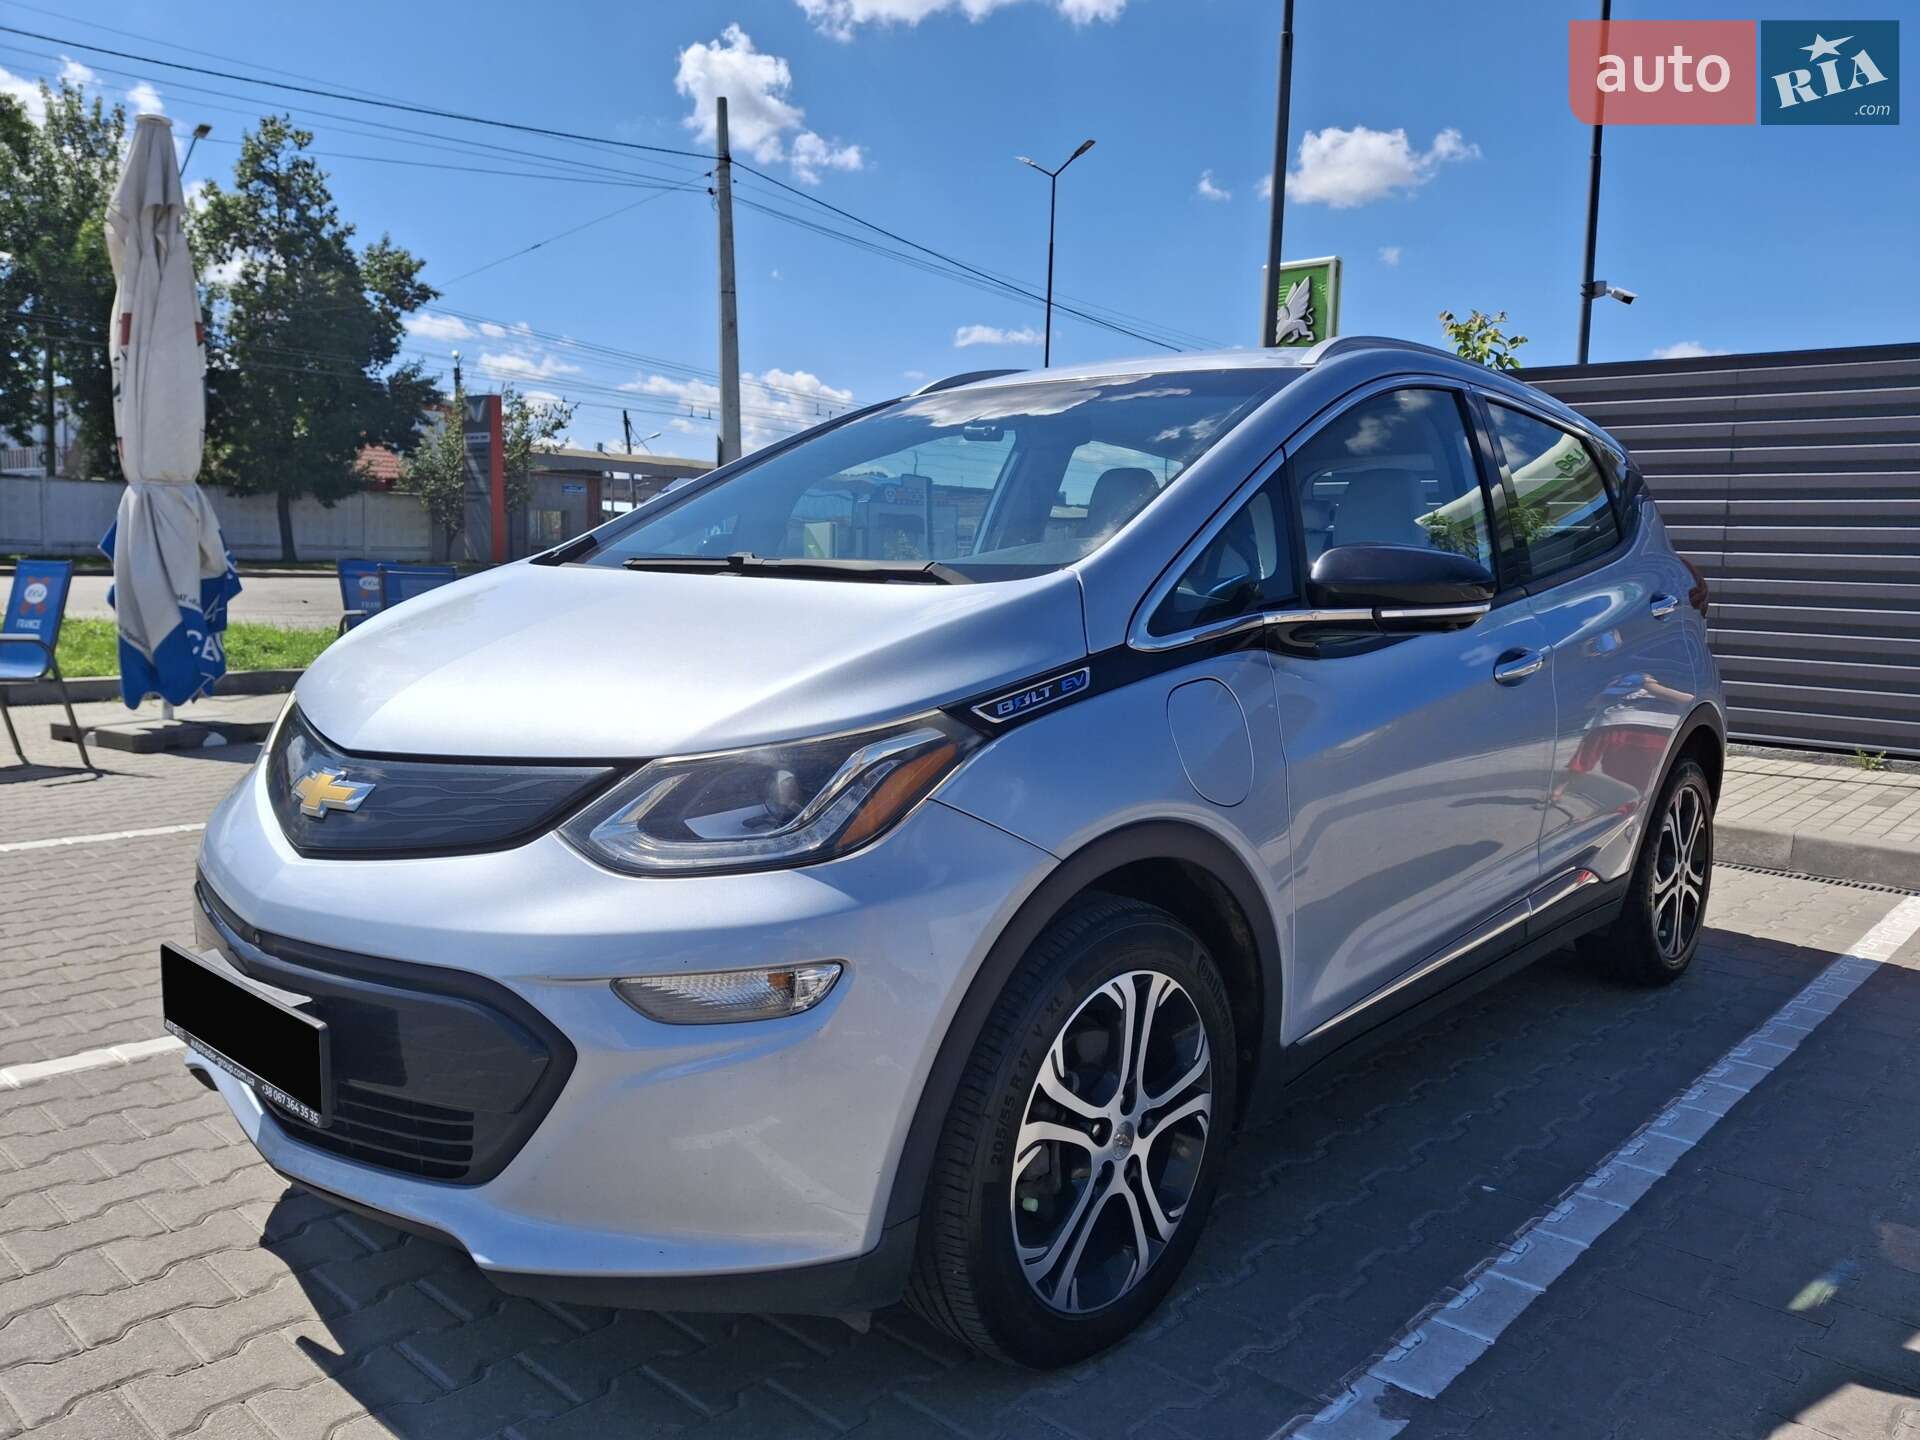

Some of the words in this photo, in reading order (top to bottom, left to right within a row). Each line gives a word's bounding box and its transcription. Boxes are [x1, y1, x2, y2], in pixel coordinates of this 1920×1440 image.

[997, 684, 1054, 715] BOLT
[1061, 672, 1085, 692] EV
[273, 1090, 286, 1105] 067
[286, 1097, 300, 1112] 364
[300, 1104, 309, 1119] 35
[309, 1110, 319, 1124] 35
